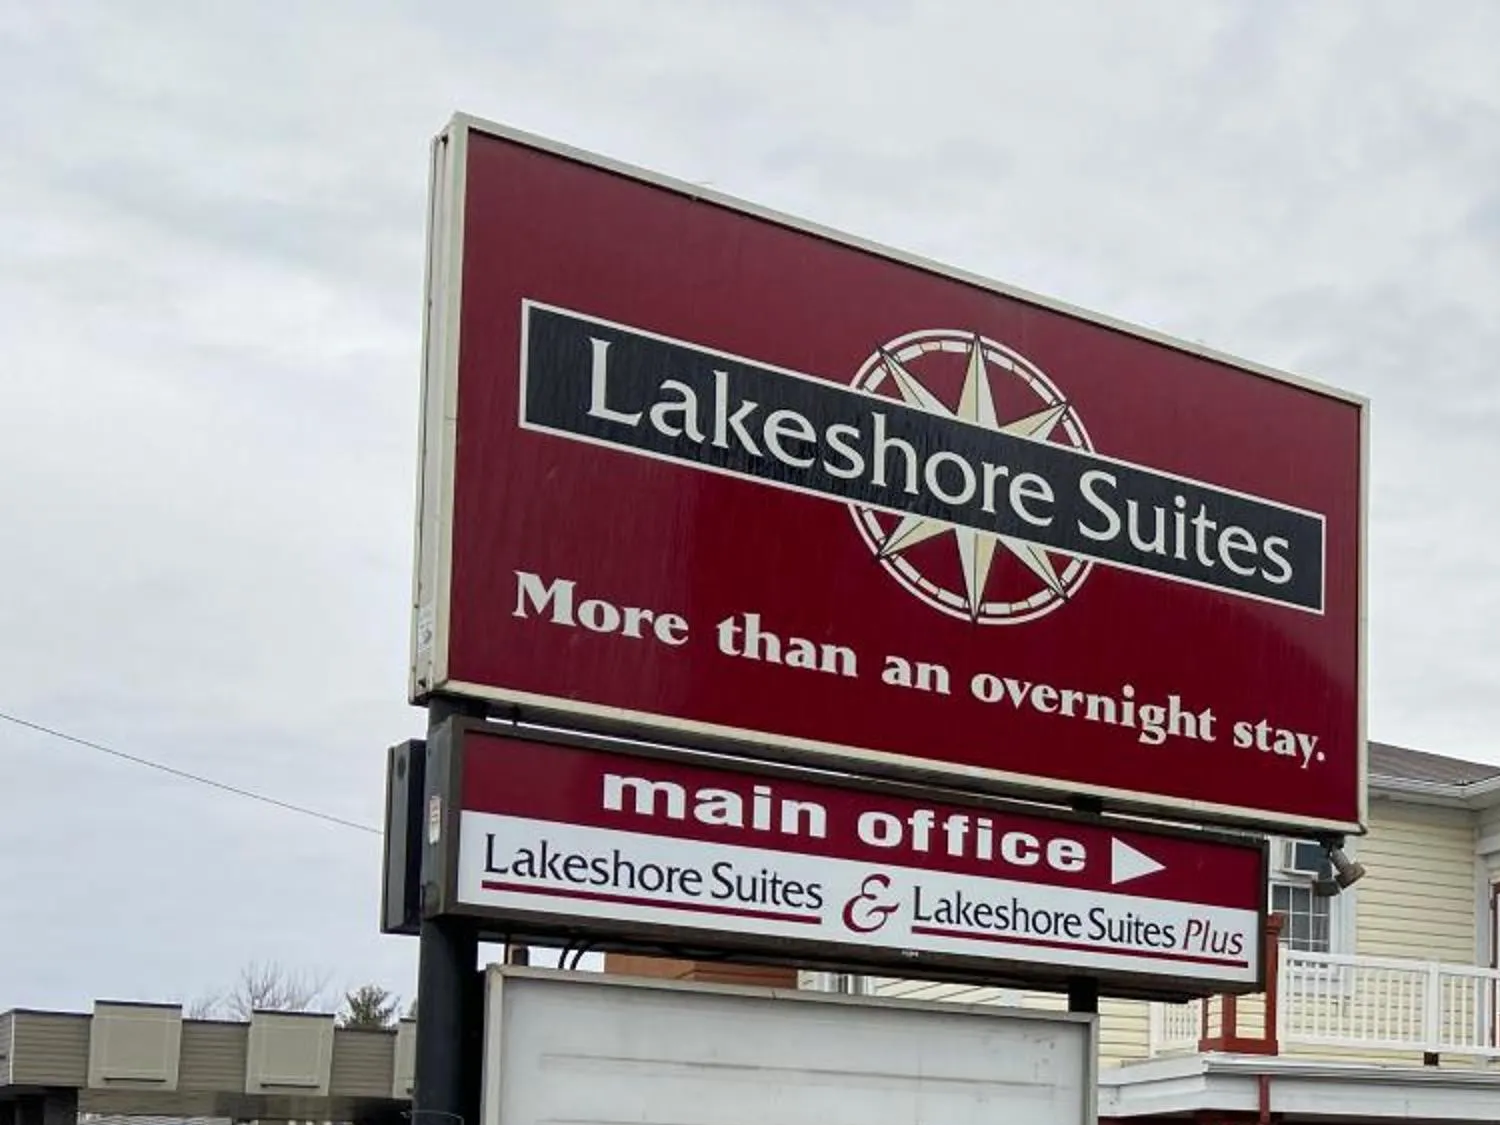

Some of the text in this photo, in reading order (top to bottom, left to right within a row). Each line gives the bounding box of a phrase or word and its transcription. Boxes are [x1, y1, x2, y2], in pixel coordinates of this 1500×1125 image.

[587, 337, 1293, 584] Lakeshore Suites
[512, 571, 1326, 769] More than an overnight stay.
[484, 833, 1243, 956] Lakeshore Suites & Lakeshore Suites Plus
[603, 773, 1086, 872] main office
